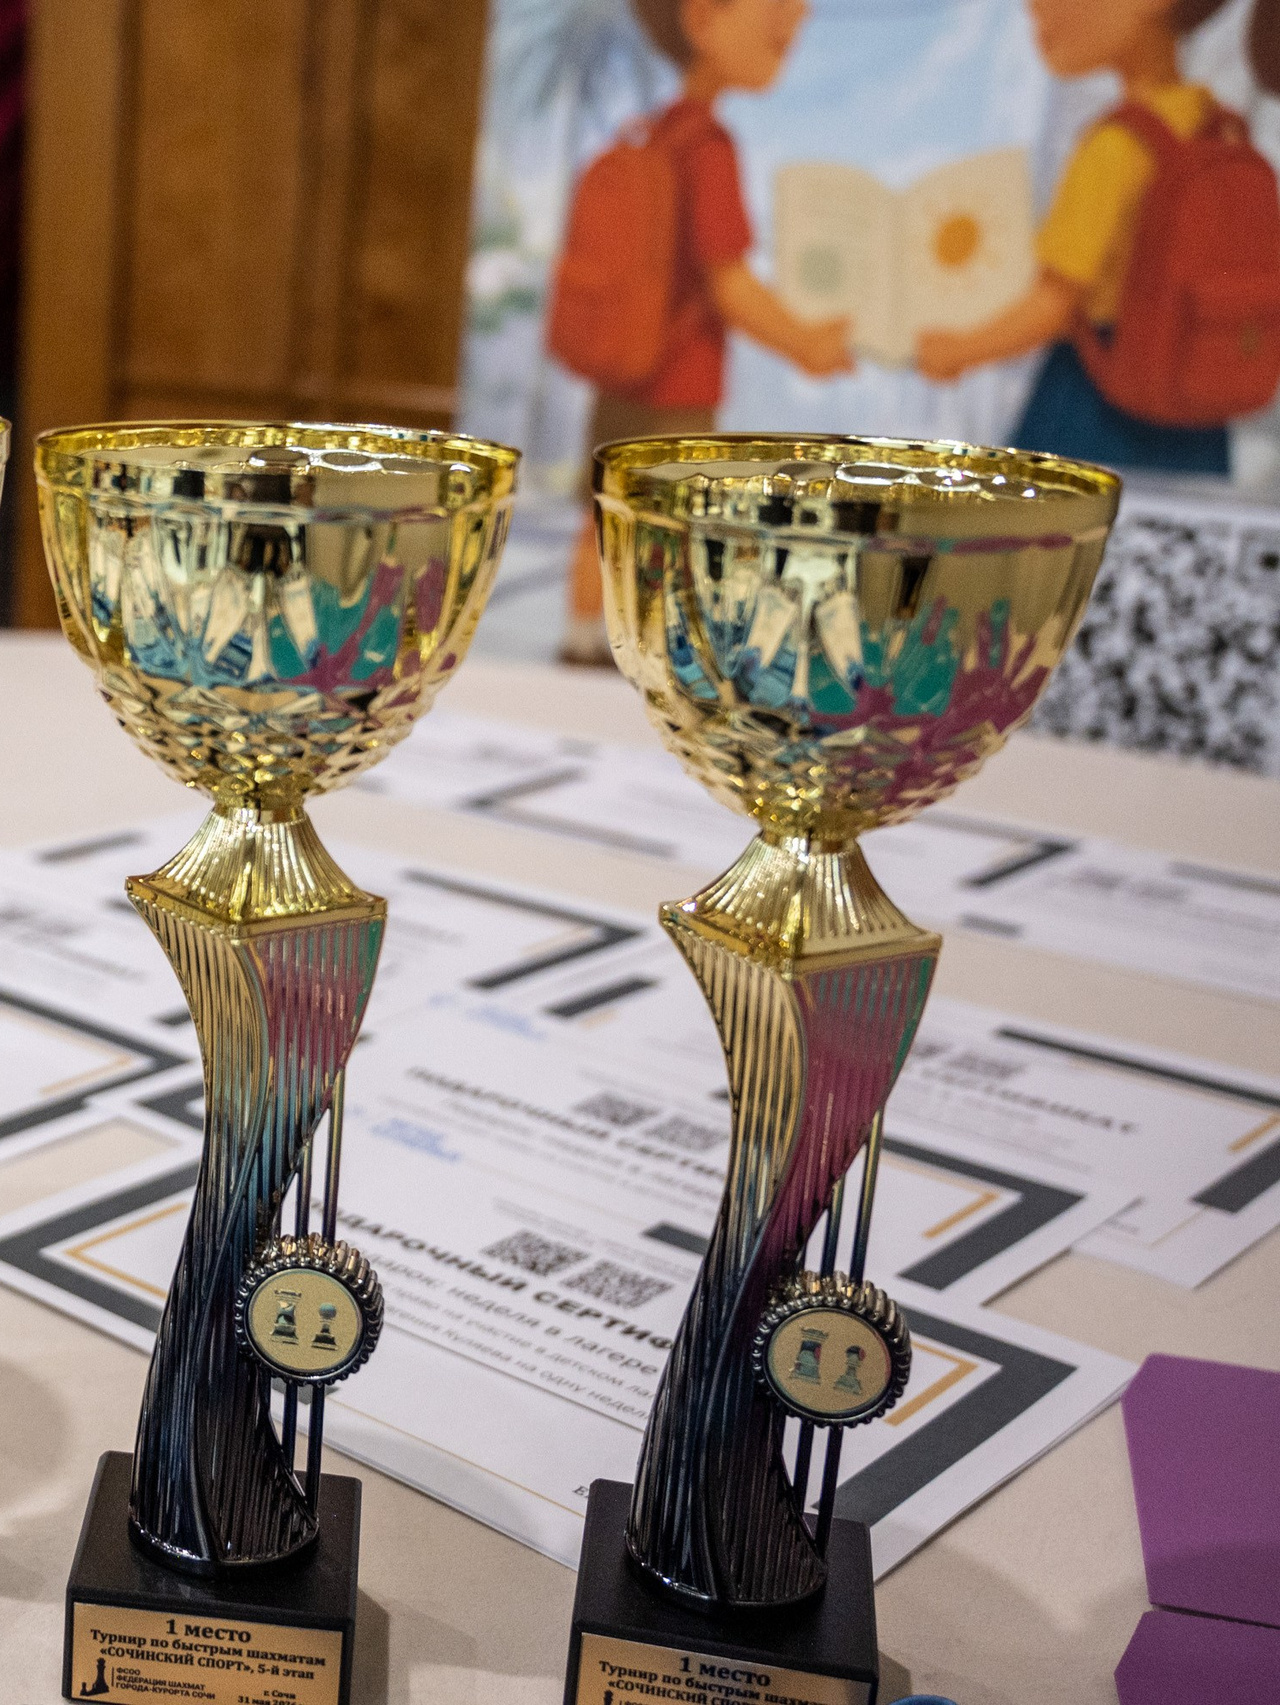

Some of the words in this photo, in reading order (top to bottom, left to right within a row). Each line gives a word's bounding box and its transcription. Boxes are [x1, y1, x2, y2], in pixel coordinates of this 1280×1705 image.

[310, 1198, 528, 1292] ПДАРОЧНЫЙ
[564, 1336, 658, 1375] лагере
[166, 1618, 178, 1635] 1
[184, 1624, 251, 1643] место
[90, 1629, 147, 1648] Турнир
[150, 1638, 169, 1648] по
[172, 1639, 243, 1657] быстрым
[247, 1649, 326, 1666] шахматам
[100, 1646, 194, 1666] «СОЧИНСКИЙ
[197, 1656, 254, 1674] СПОРТ»,
[258, 1663, 280, 1676] 5-й
[283, 1668, 315, 1680] этап
[168, 1680, 206, 1690] ШАХМАТ
[599, 1660, 658, 1683] Турнир
[662, 1674, 681, 1685] по
[685, 1677, 760, 1700] быстрым
[679, 1656, 691, 1673] 1
[699, 1663, 771, 1687] место
[237, 1695, 250, 1704] 31
[271, 1689, 296, 1699] Сочи
